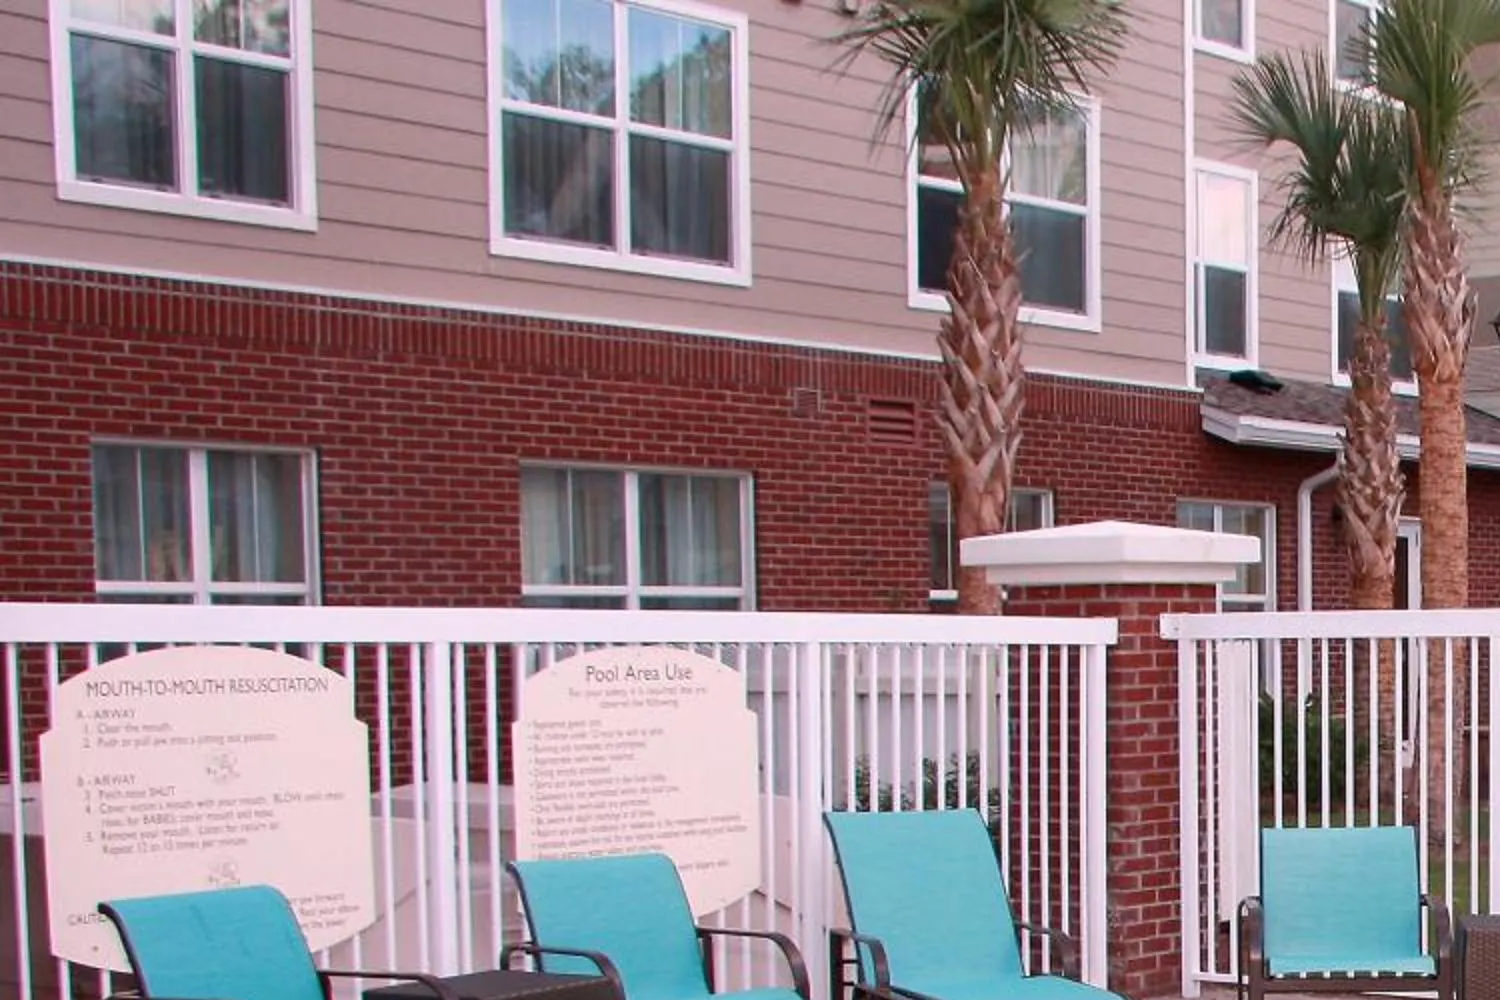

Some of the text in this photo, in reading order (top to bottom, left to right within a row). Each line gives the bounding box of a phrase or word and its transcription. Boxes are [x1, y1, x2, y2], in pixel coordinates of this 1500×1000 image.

[585, 663, 693, 682] Pool Area Use
[86, 677, 329, 697] MOUTH-TO-MOUTH RESUSCITATION
